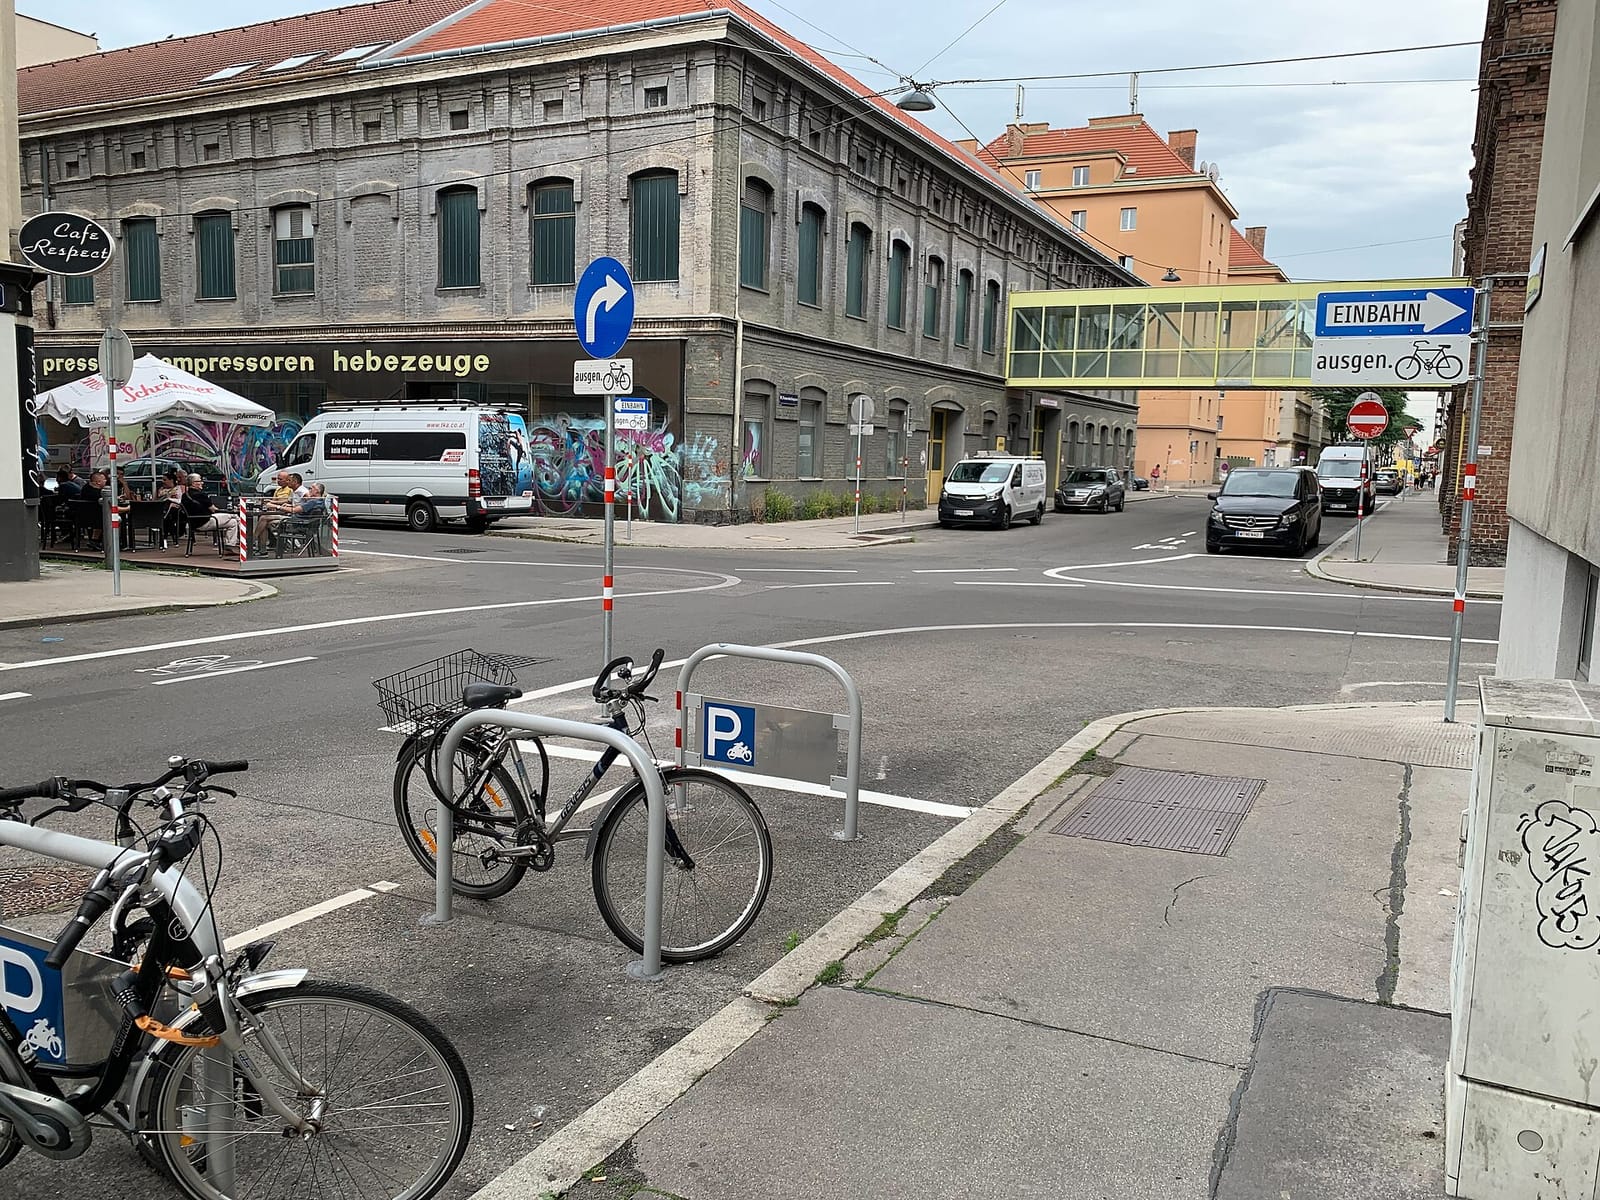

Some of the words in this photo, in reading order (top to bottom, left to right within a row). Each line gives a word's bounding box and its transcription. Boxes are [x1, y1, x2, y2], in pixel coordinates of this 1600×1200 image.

[53, 222, 99, 245] Cafe
[22, 238, 108, 263] Respect
[1333, 303, 1421, 324] EINBAHN
[333, 349, 490, 377] hebezeuge
[1317, 353, 1393, 374] ausgen.
[575, 371, 603, 385] ausgen.
[621, 402, 644, 410] EINBAHN
[707, 706, 742, 757] P
[0, 945, 43, 1014] P
